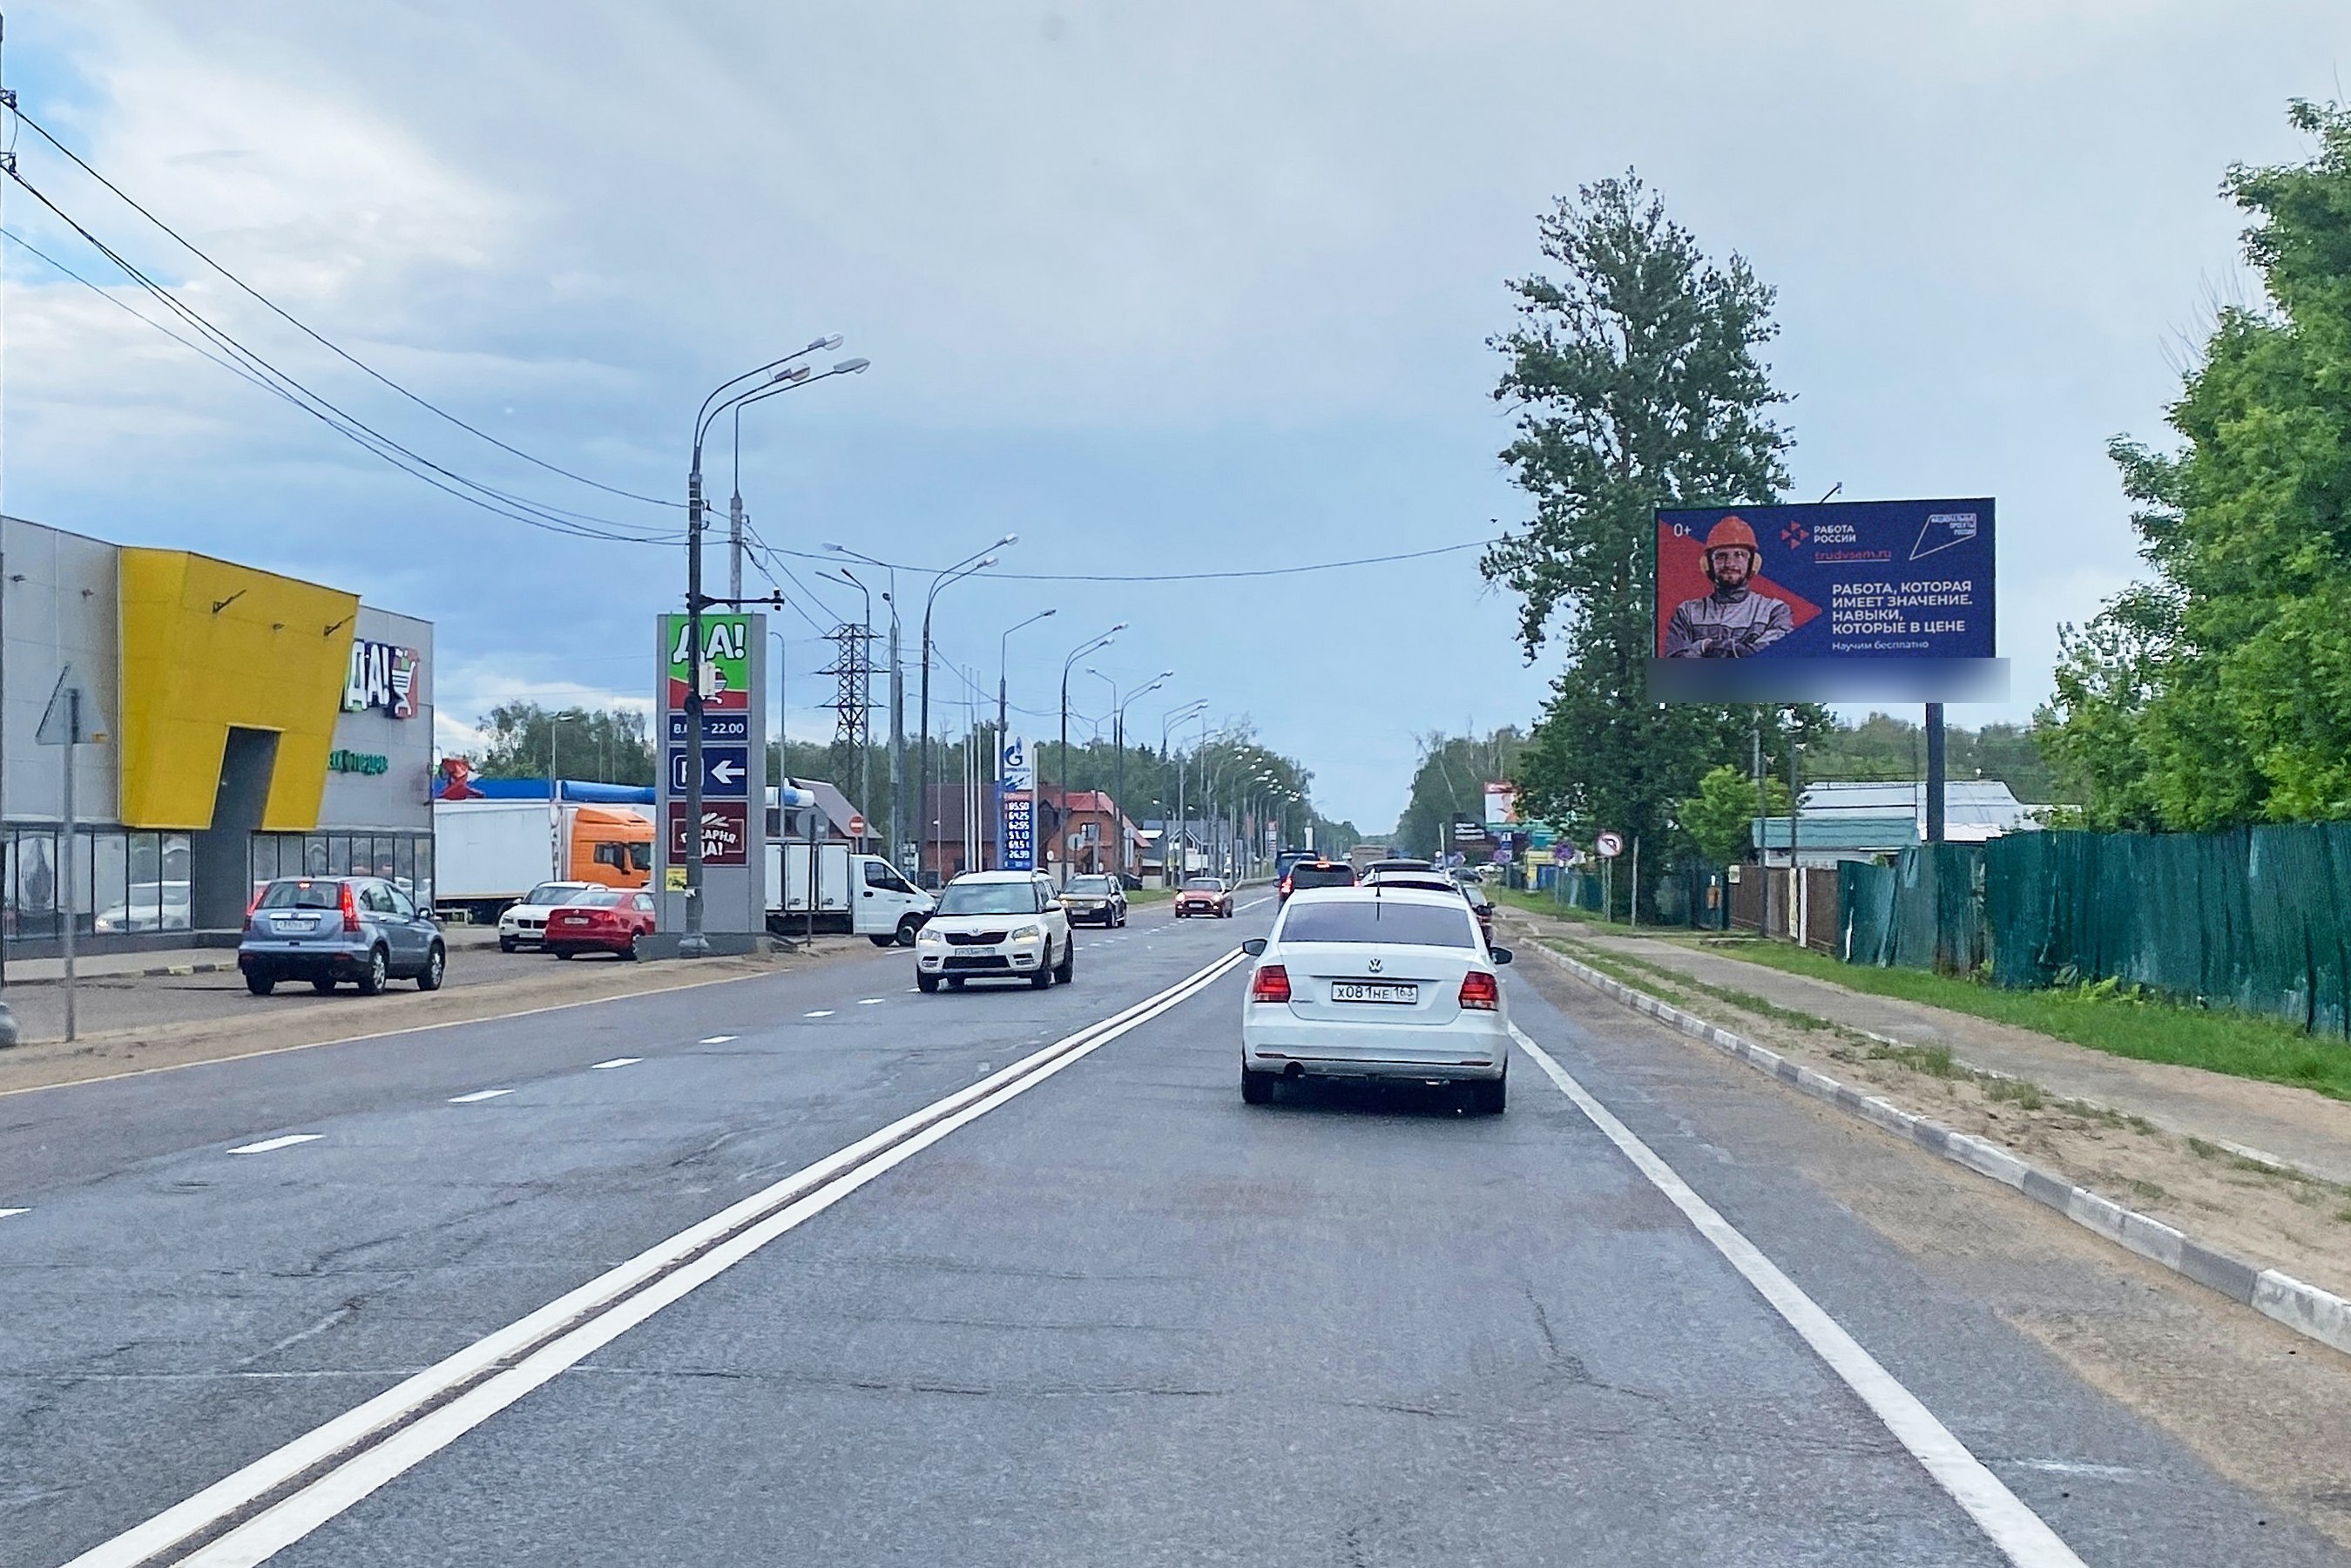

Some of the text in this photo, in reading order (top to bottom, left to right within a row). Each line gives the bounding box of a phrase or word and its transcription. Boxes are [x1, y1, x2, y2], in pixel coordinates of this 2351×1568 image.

[1673, 523, 1692, 537] 0+
[1814, 524, 1854, 534] РАБОТА
[1814, 534, 1856, 544] РОССИИ
[1814, 550, 1892, 560] trudvsem.ru
[1832, 580, 1972, 595] РАБОТА, КОТОРАЯ
[1832, 594, 1974, 608] ИМЕЕТ ЗНАЧЕНИЕ.
[1832, 609, 1903, 621] НАВЫКИ,
[1832, 619, 1966, 634] КОТОРЫЕ В ЦЕНЕ
[1832, 640, 1929, 652] Научим бесплатно
[345, 641, 389, 711] ДА!
[711, 722, 745, 734] 22.00
